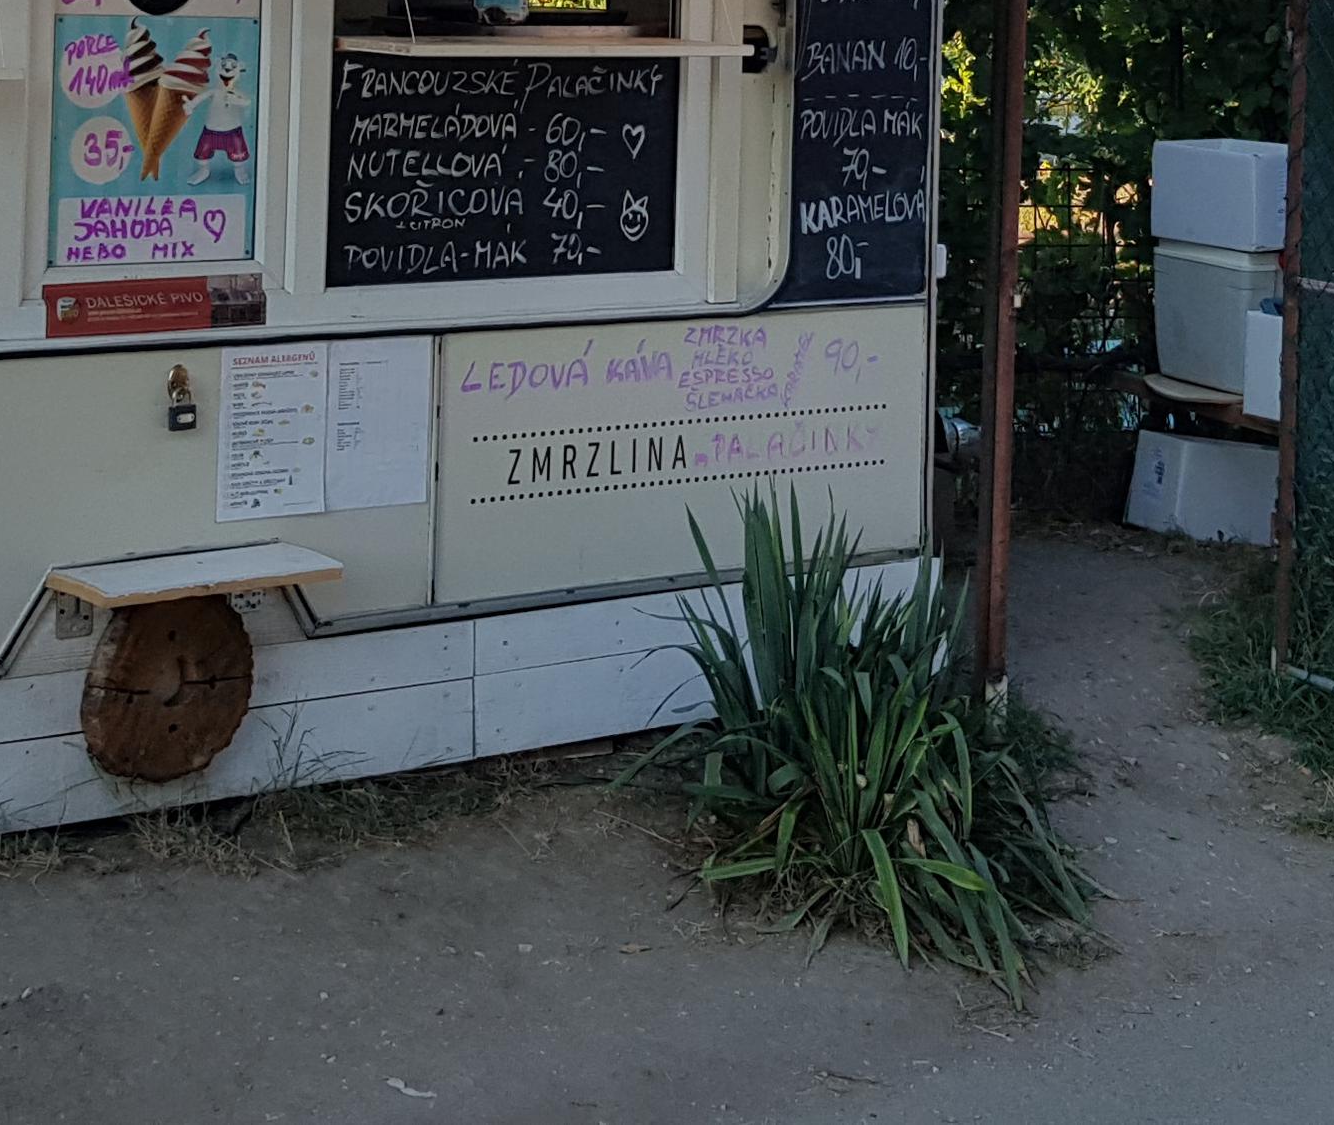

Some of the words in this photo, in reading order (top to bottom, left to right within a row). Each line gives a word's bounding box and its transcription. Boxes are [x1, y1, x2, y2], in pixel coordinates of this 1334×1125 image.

[64, 33, 119, 66] PORCE
[336, 59, 519, 110] FRANCOUZSKÉ
[520, 61, 664, 114] PALAČINKY
[348, 99, 519, 146] MARMELÁDOVÁ
[800, 106, 877, 148] POVIDLA
[883, 101, 924, 140] MÁK
[347, 144, 508, 182] NUTELLOVÁ
[799, 165, 927, 236] KARAMELOVÁ
[73, 218, 174, 242] JAHODA
[66, 242, 127, 262] NEBO
[151, 240, 196, 259] MIX
[85, 291, 167, 310] DALEŠICKÉ
[170, 291, 205, 304] PIVO
[683, 324, 768, 350] ZMRZKA
[232, 355, 269, 367] SEZNAM
[270, 350, 317, 365] ALERGENŮ
[460, 338, 596, 401] LEDOVÁ
[605, 338, 674, 384] KÁVA
[677, 366, 775, 391] ESPRESSO
[506, 434, 689, 486] ZMRZLINA
